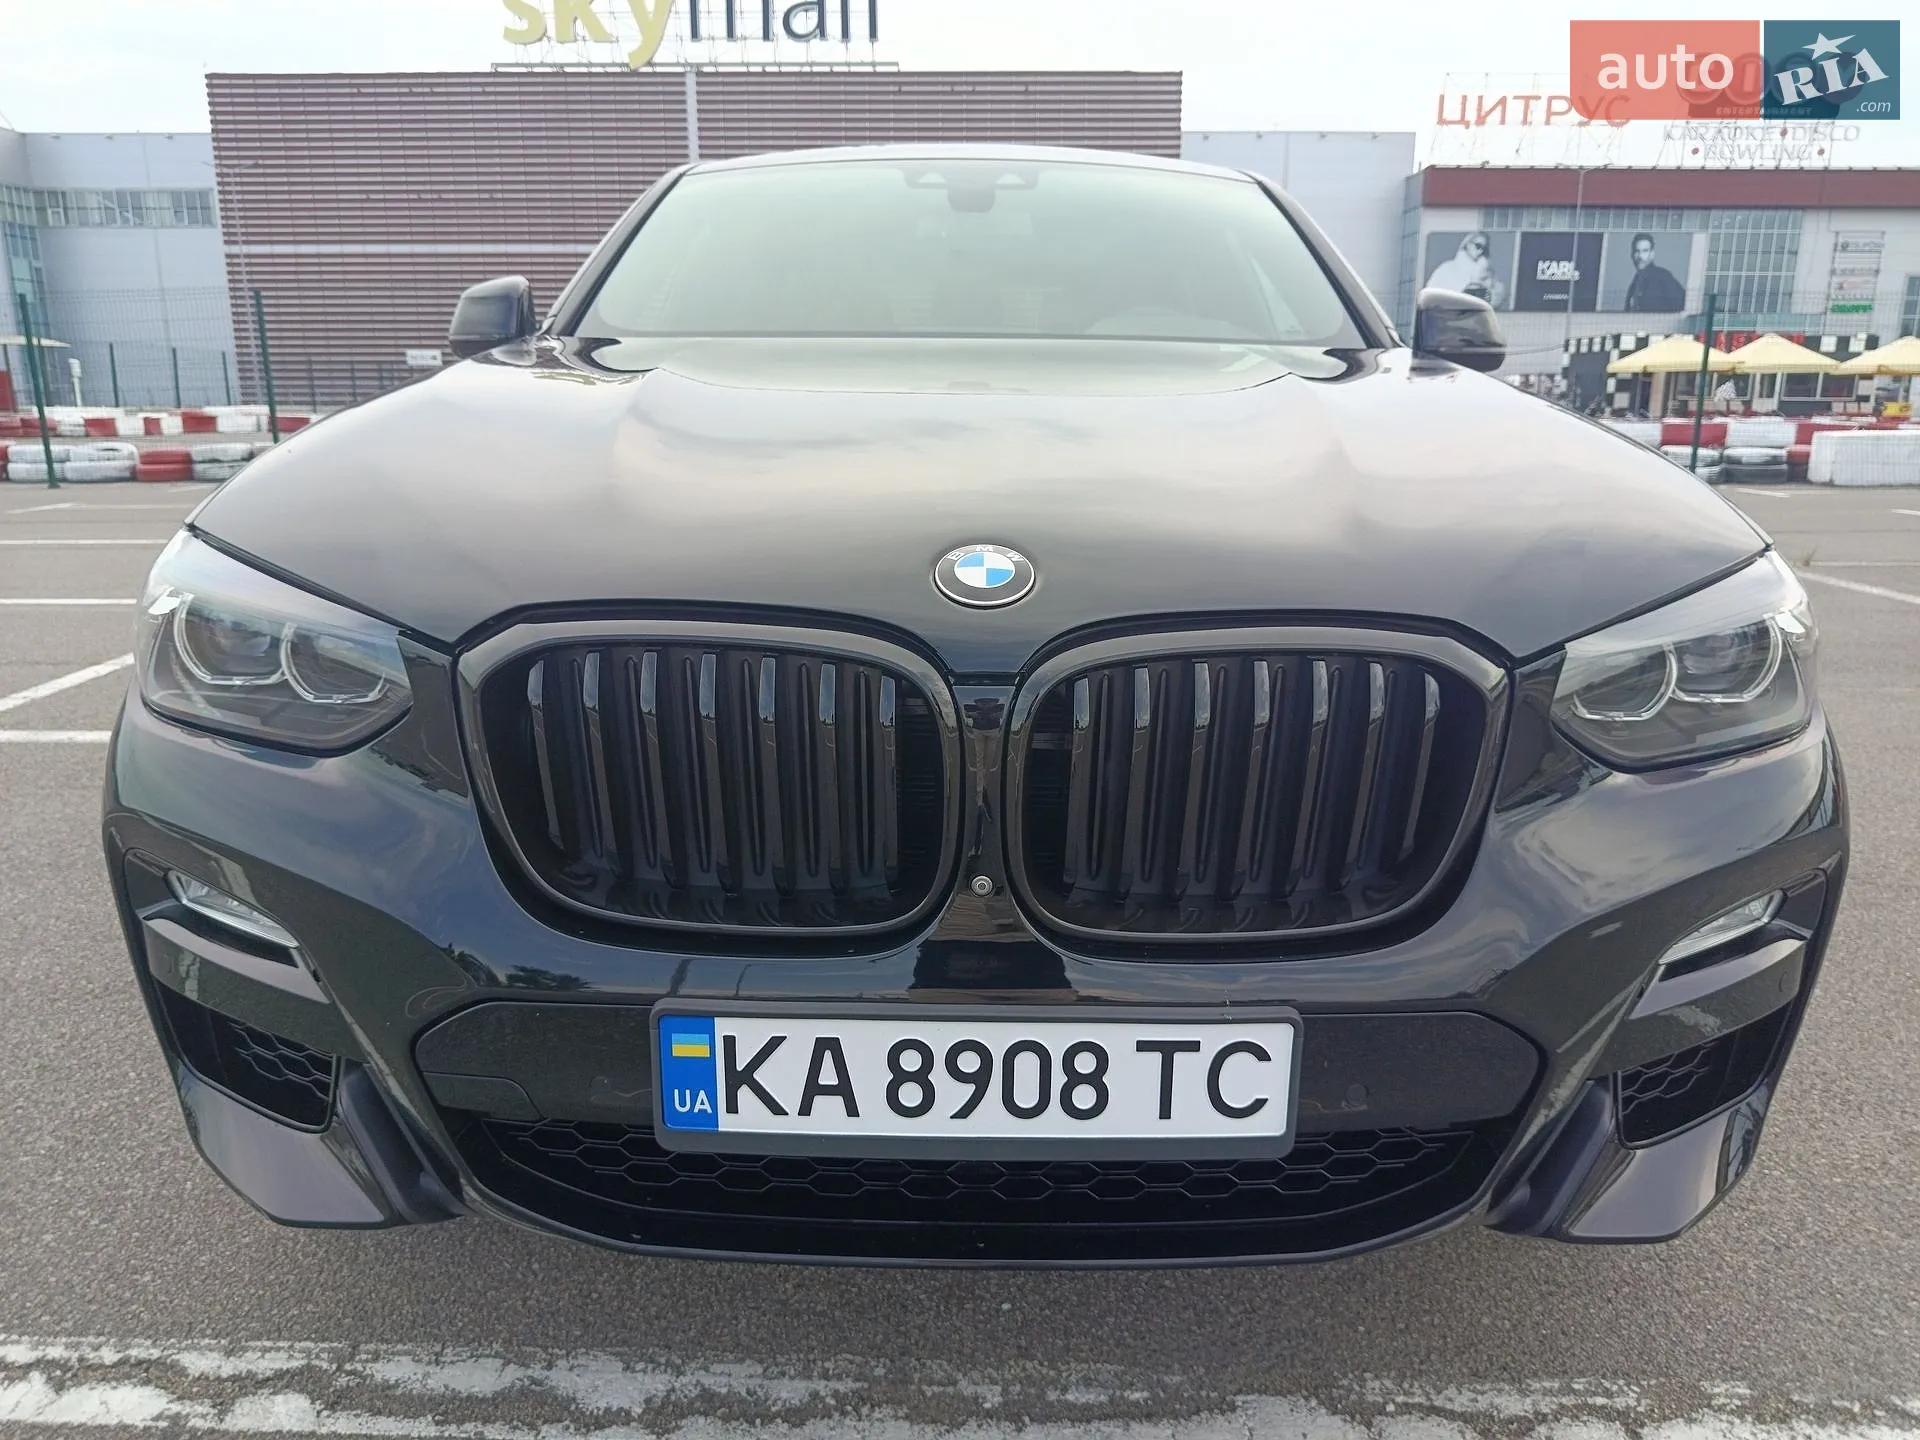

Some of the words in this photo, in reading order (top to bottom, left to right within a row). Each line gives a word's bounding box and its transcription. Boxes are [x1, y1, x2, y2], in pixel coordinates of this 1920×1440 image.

[1437, 94, 1632, 129] ЦИТРУС
[722, 1034, 860, 1118] KA
[886, 1038, 1109, 1120] 8908
[1136, 1039, 1273, 1120] TC
[673, 1089, 712, 1114] UA
